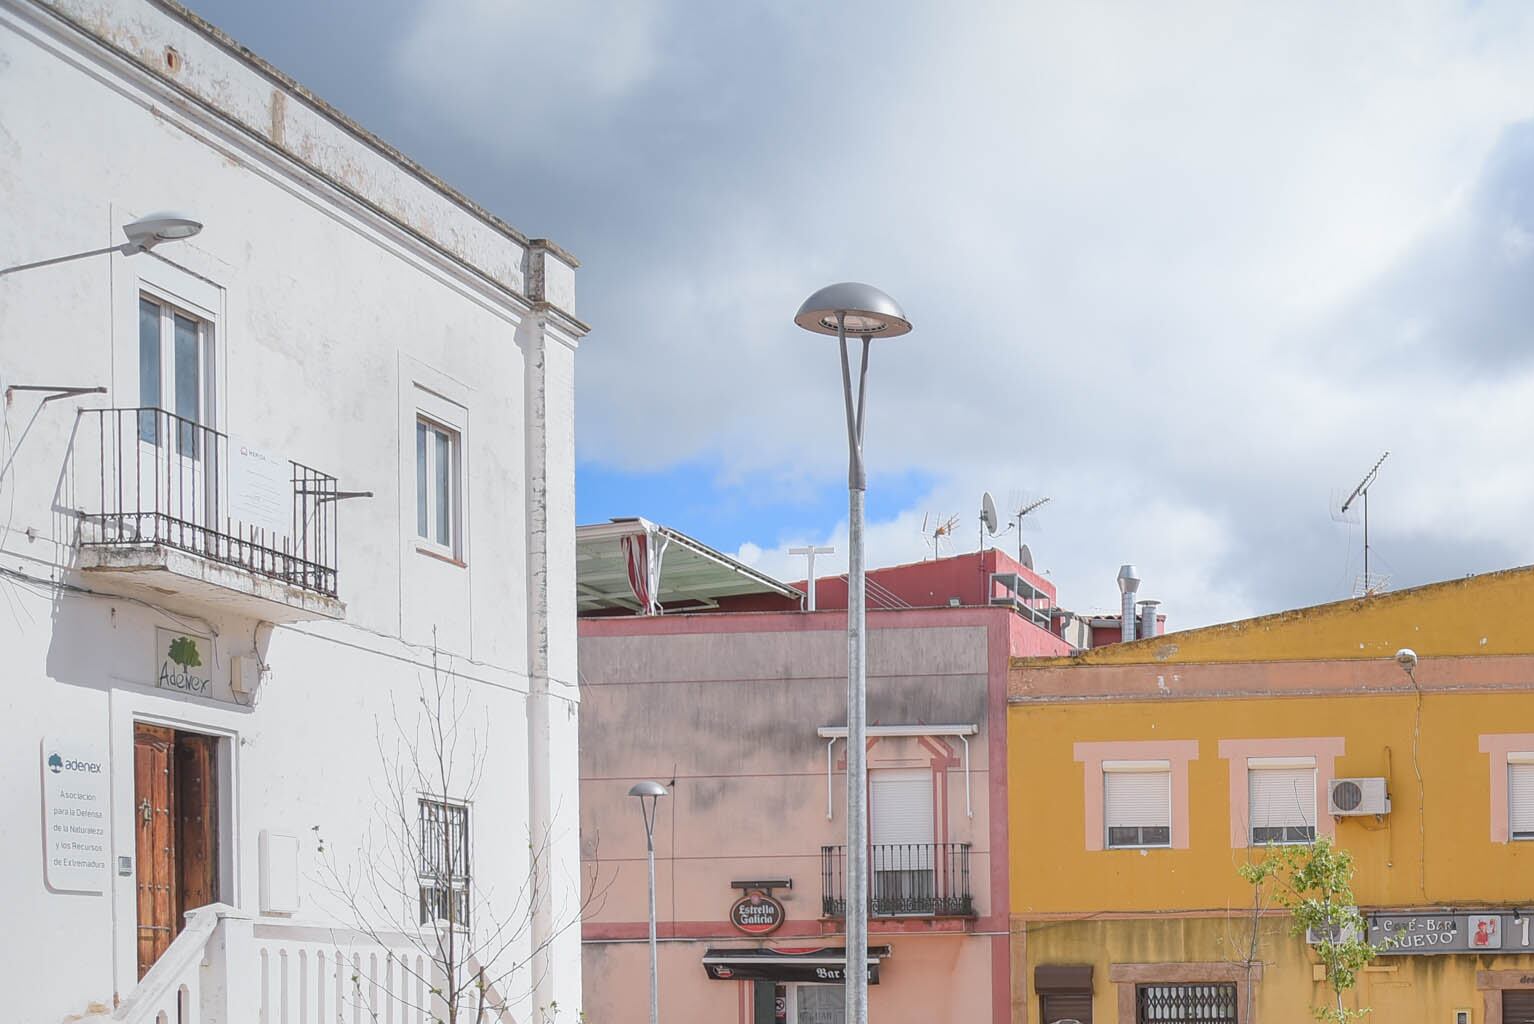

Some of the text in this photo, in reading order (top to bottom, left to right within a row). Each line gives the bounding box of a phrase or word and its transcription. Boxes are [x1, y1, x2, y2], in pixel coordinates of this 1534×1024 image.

[64, 759, 102, 774] adenex
[53, 807, 103, 819] para la Defensa
[53, 823, 104, 836] de la Naturaleza
[61, 841, 71, 850] los
[72, 841, 103, 852] Recursos
[53, 857, 105, 869] de Extremadura
[738, 904, 775, 914] Estrella
[740, 913, 773, 924] Galicia
[1383, 931, 1453, 950] NUEVO
[816, 967, 840, 979] Bar
